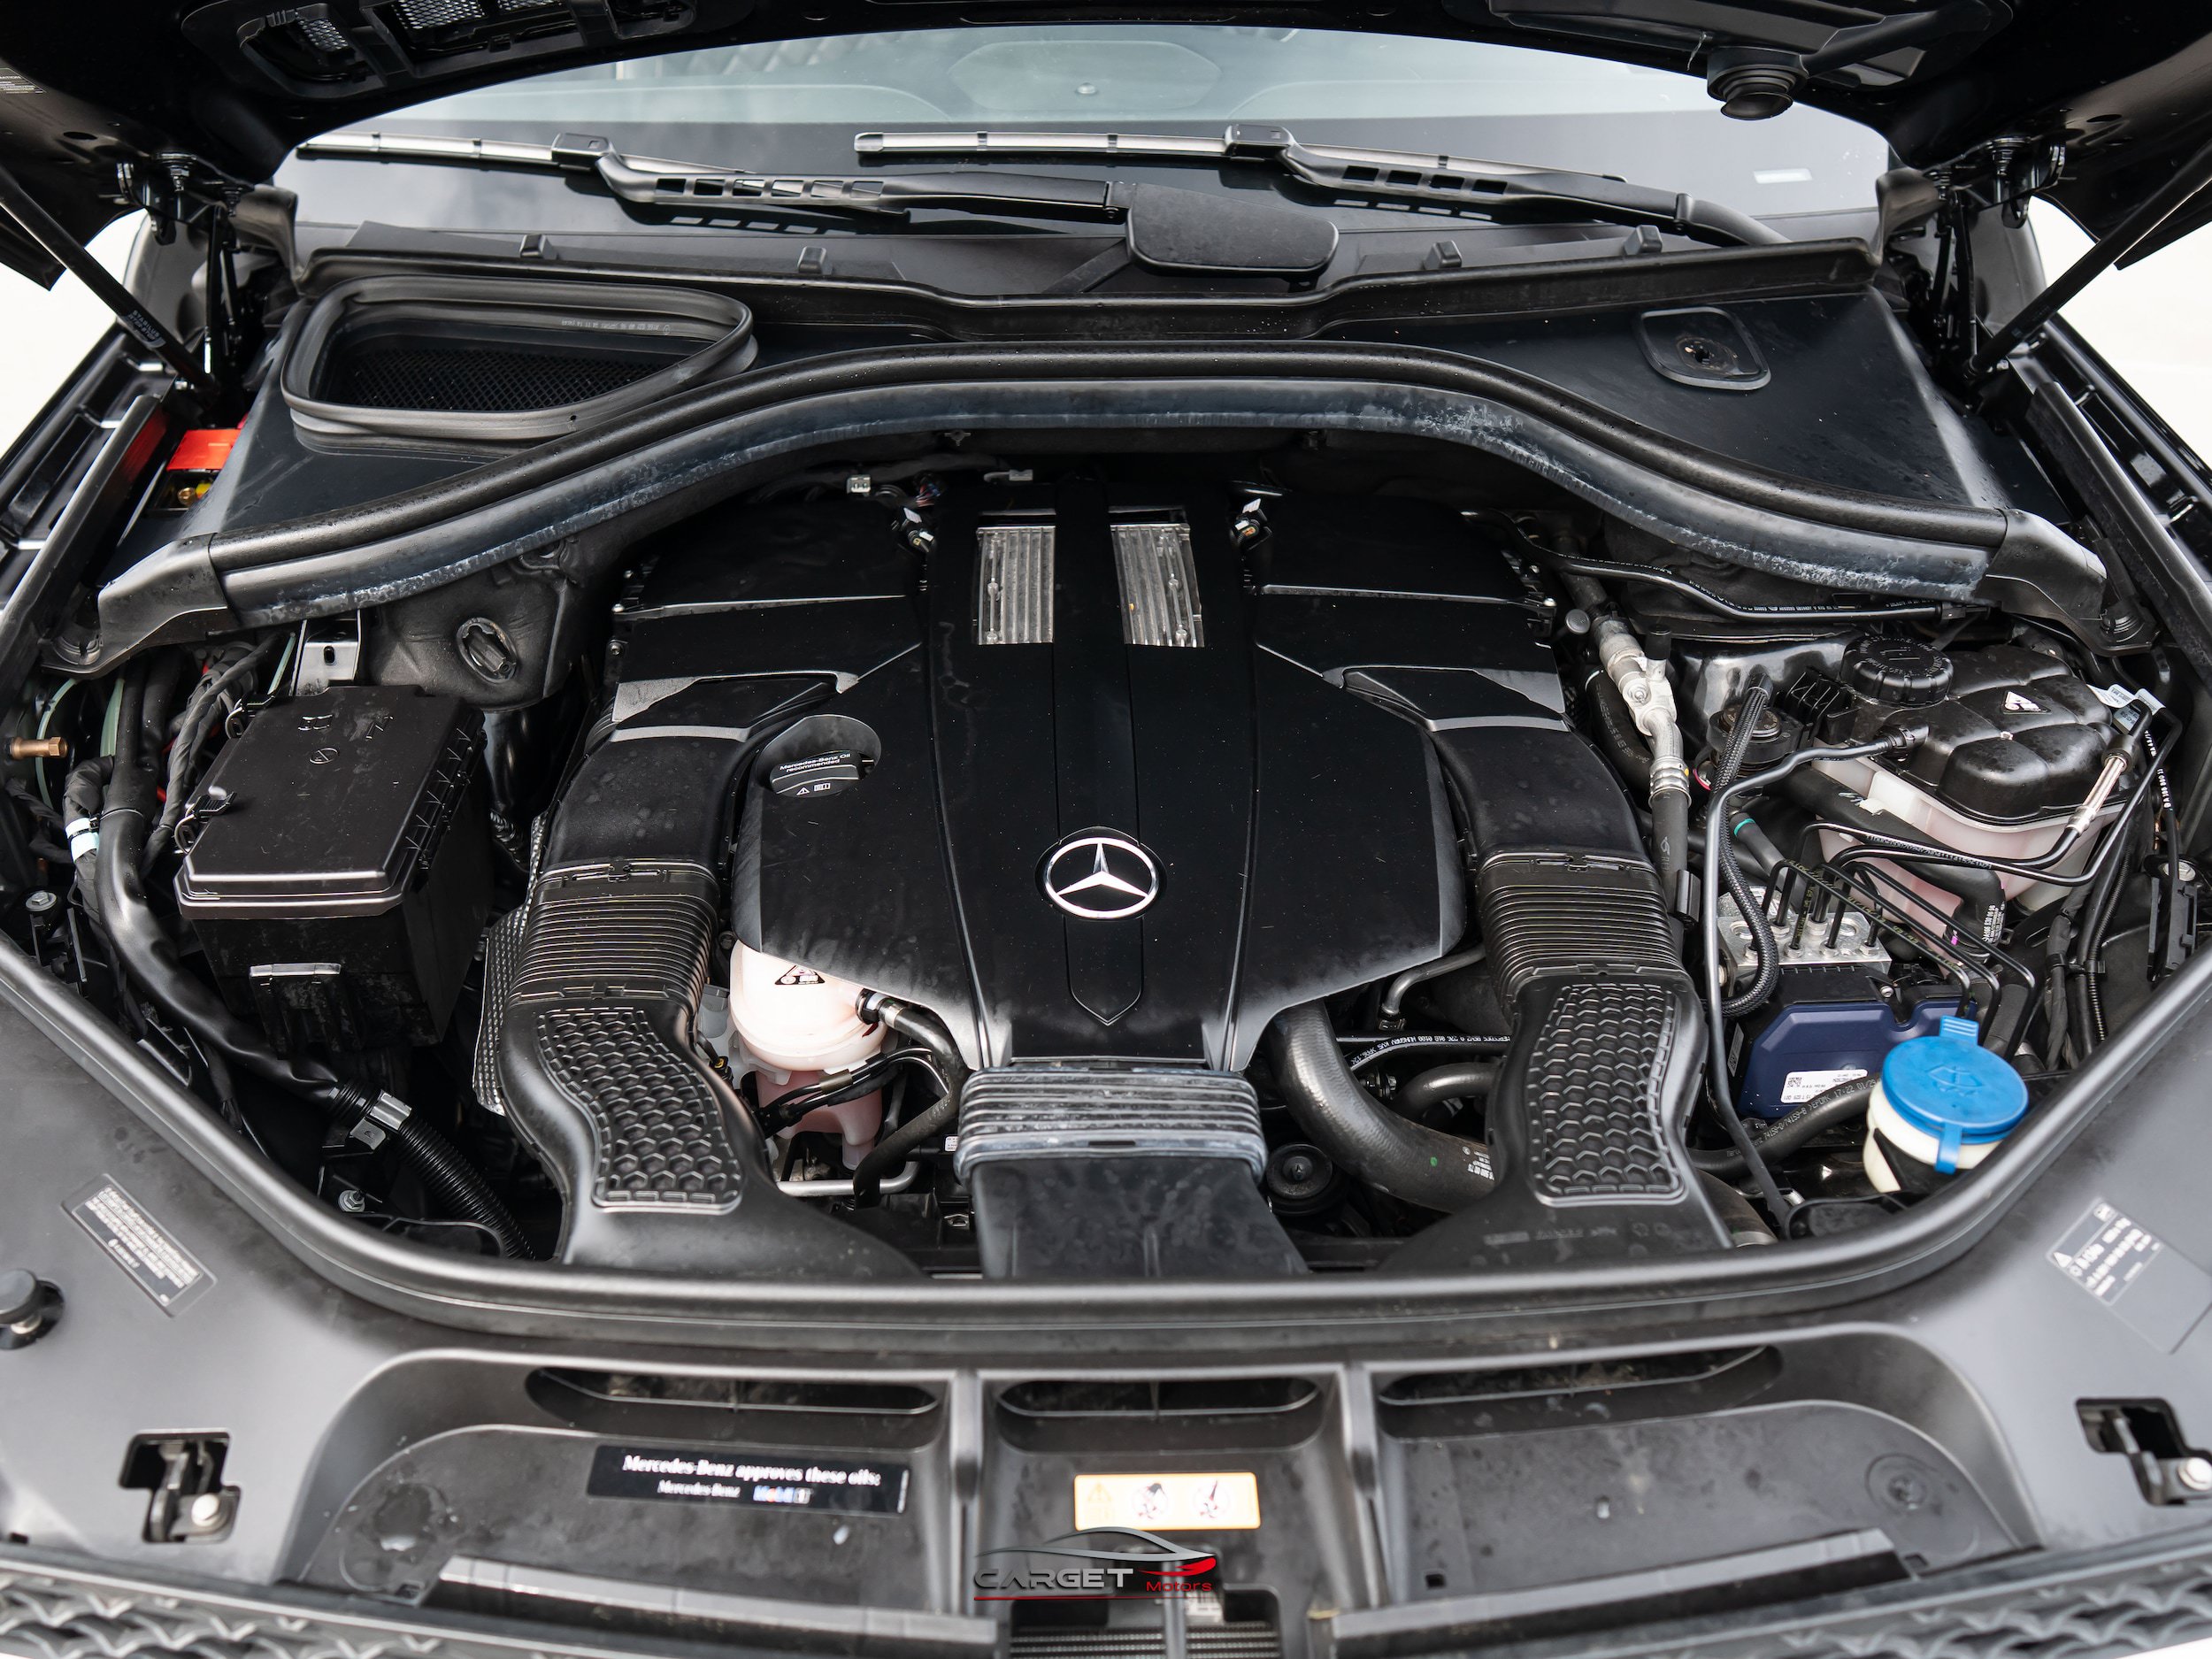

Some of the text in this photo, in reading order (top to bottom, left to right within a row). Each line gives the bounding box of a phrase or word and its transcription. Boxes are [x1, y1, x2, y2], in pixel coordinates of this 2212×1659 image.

[780, 755, 838, 771] Mercedes-Benz
[786, 758, 841, 773] recommended
[622, 1455, 881, 1486] Mercedes-Benz approves these oils:
[657, 1479, 741, 1498] Mercedes-Benz
